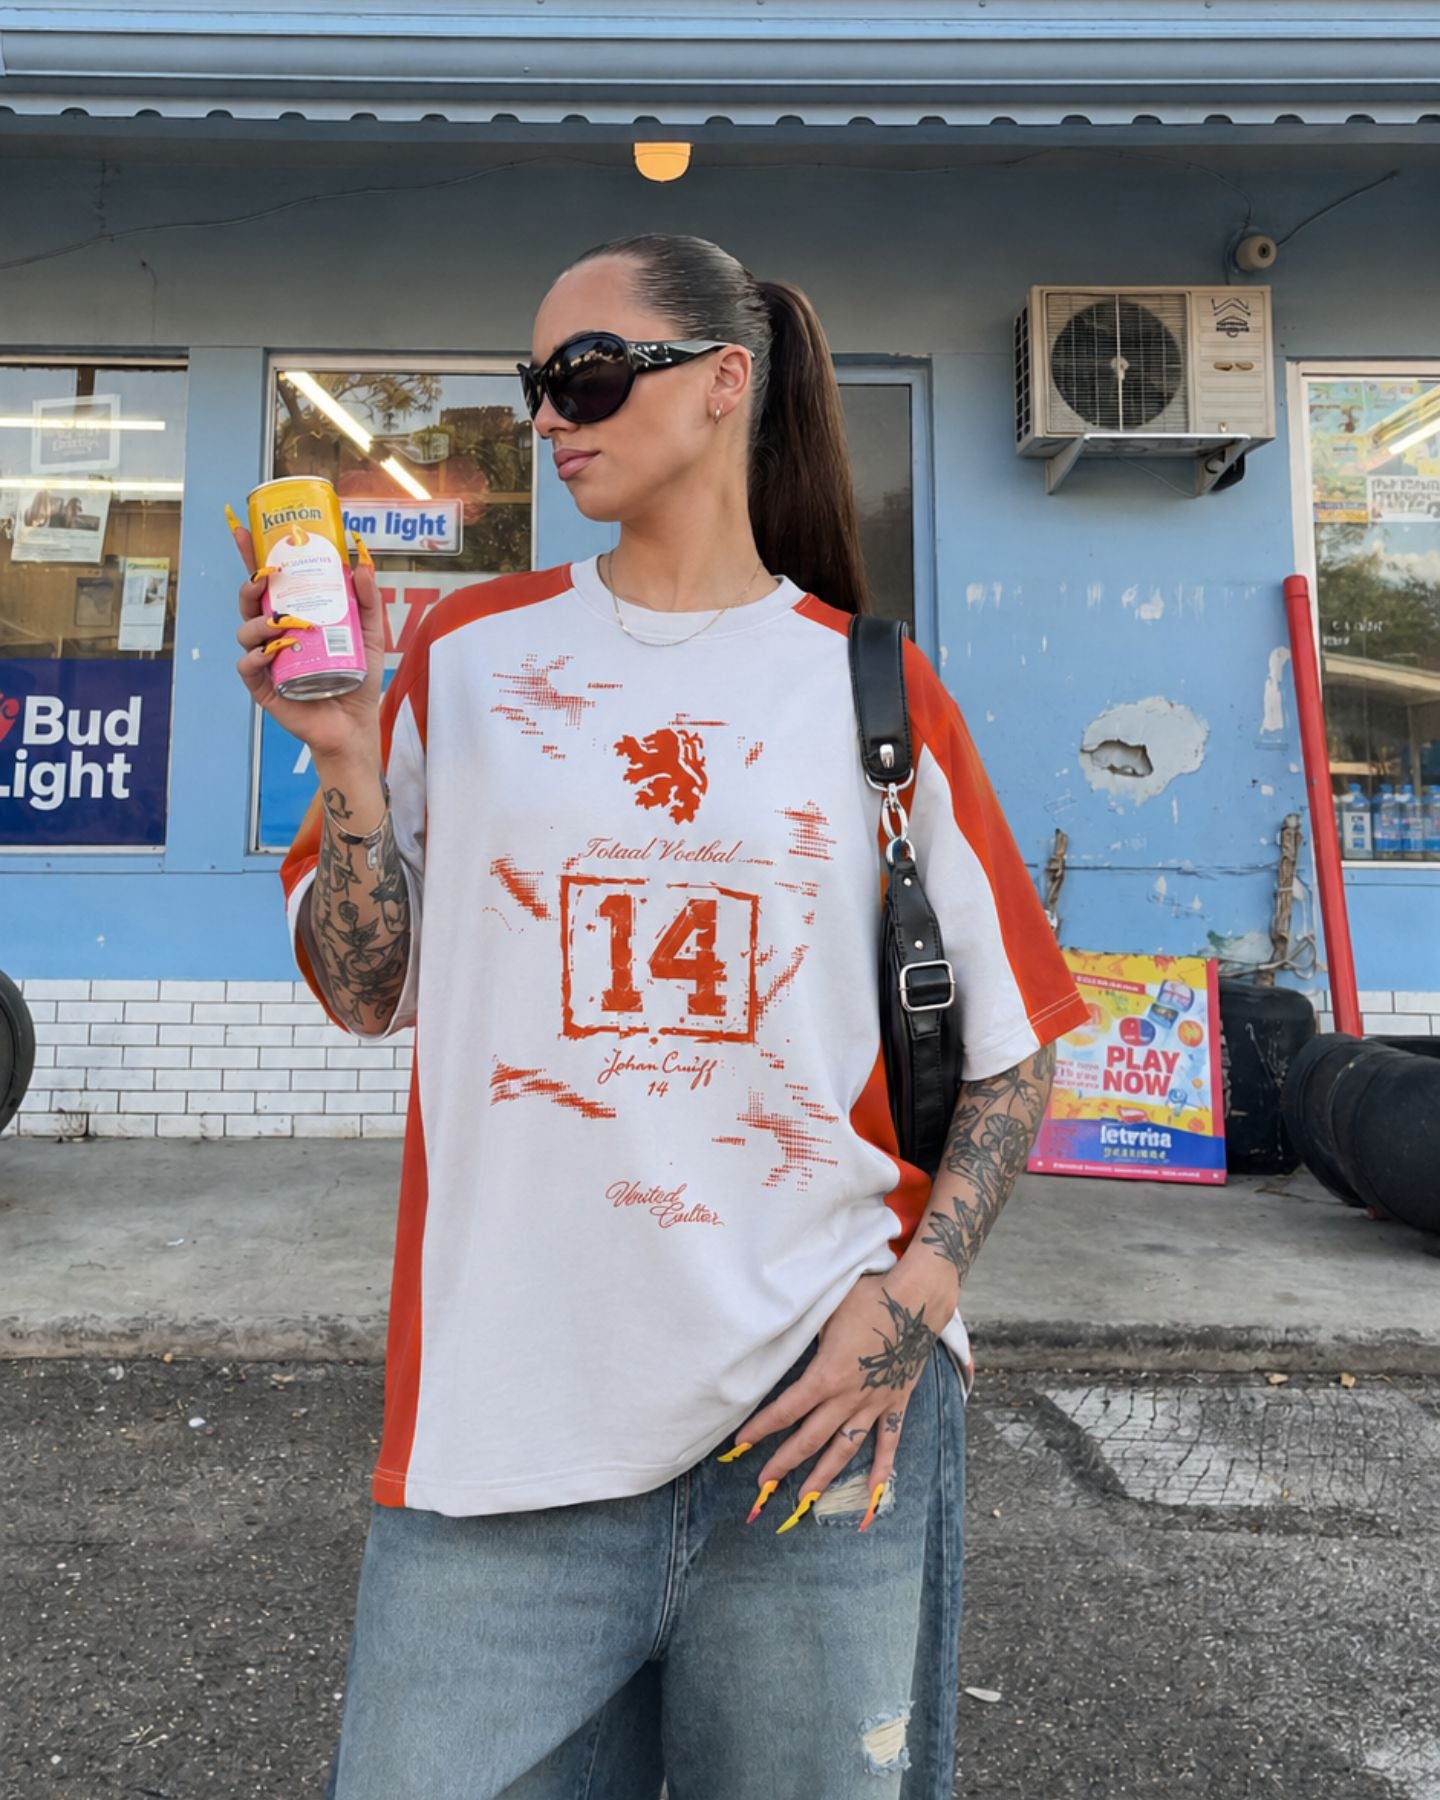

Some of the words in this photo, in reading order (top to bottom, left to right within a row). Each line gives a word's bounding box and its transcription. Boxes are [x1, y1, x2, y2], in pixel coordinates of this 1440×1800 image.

[385, 511, 446, 541] light
[23, 696, 142, 746] Bud
[0, 749, 132, 811] ight
[579, 837, 658, 861] Totaal
[599, 894, 728, 1017] 14
[597, 1048, 659, 1085] Johan
[1106, 1046, 1180, 1074] PLAY
[647, 1081, 669, 1097] 14
[1103, 1069, 1172, 1097] NOW
[605, 1180, 687, 1208] United
